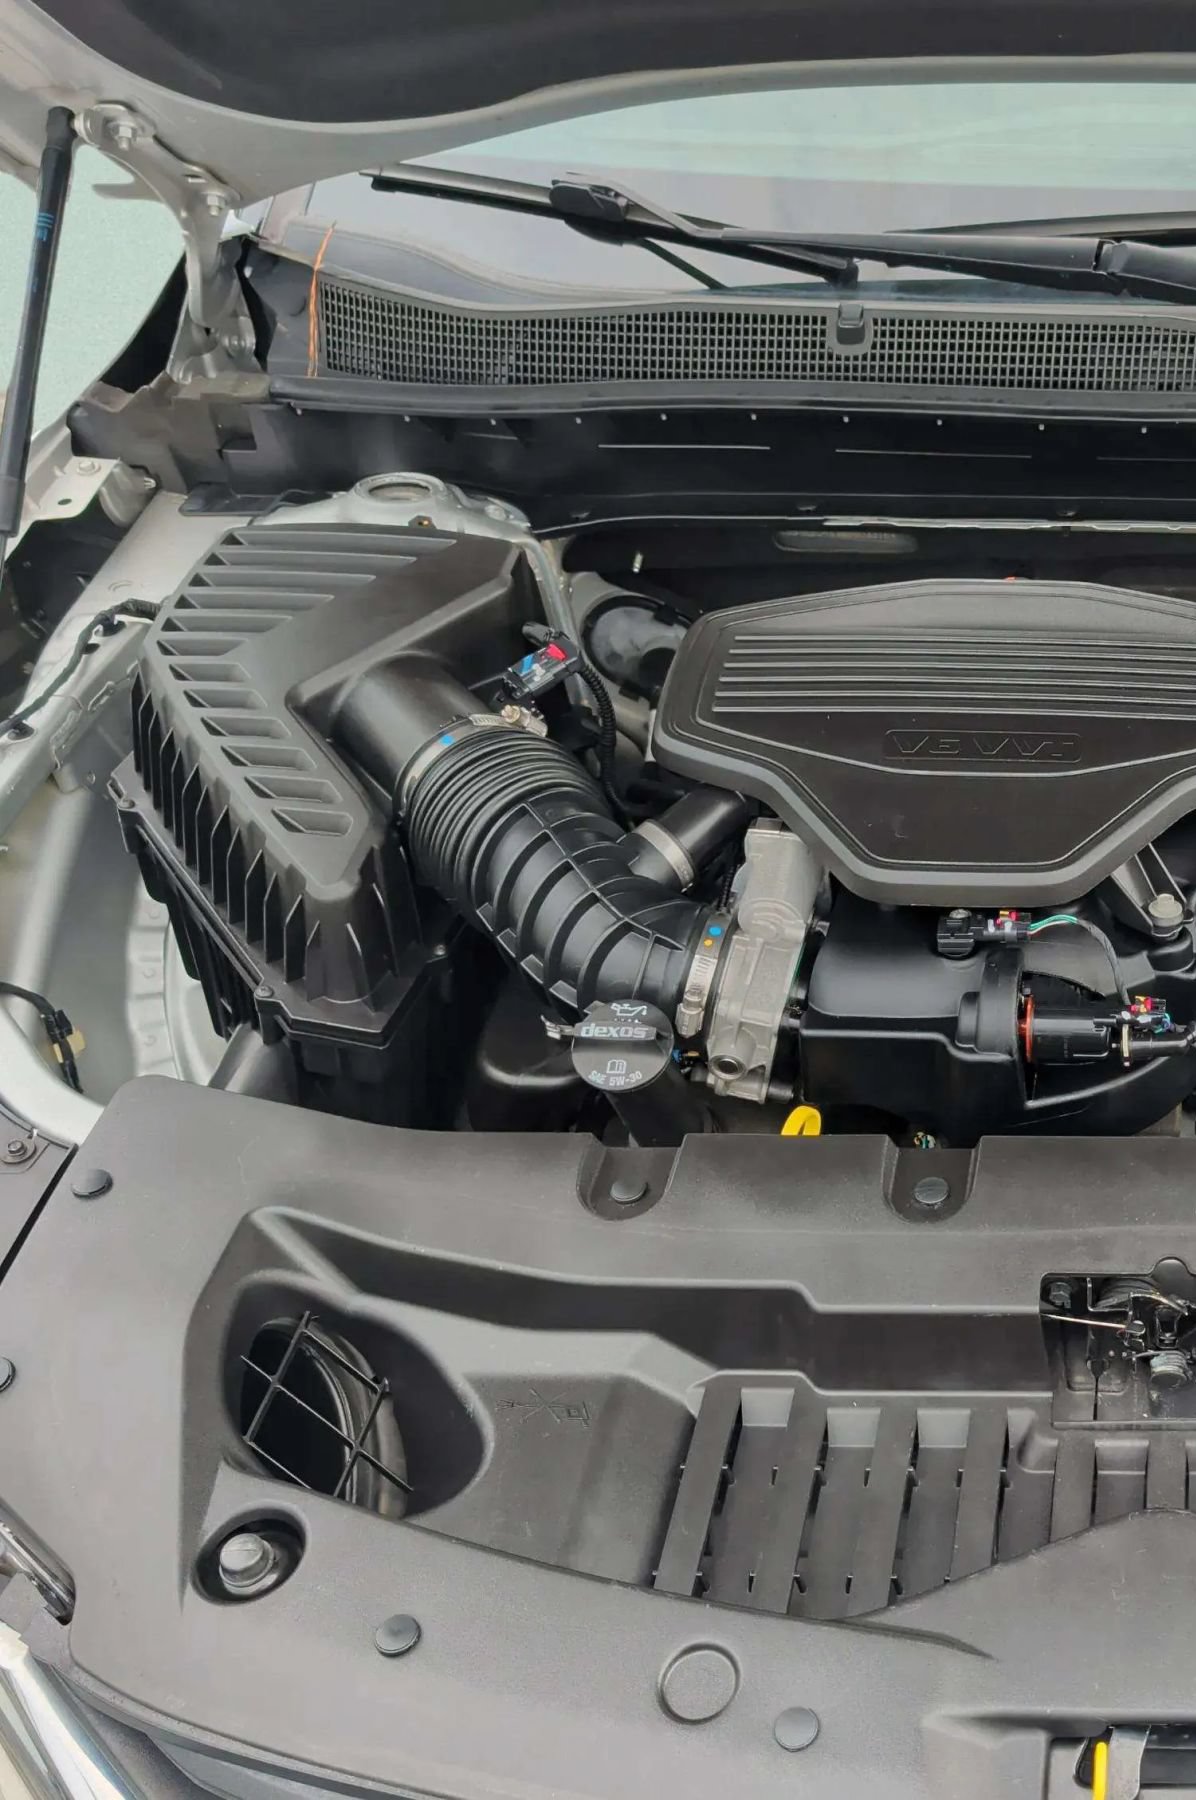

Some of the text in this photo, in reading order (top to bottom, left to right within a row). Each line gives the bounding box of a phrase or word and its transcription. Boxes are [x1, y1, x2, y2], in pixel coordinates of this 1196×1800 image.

[892, 735, 961, 754] V6
[580, 1023, 649, 1039] dexos
[608, 1071, 643, 1086] 5W-30
